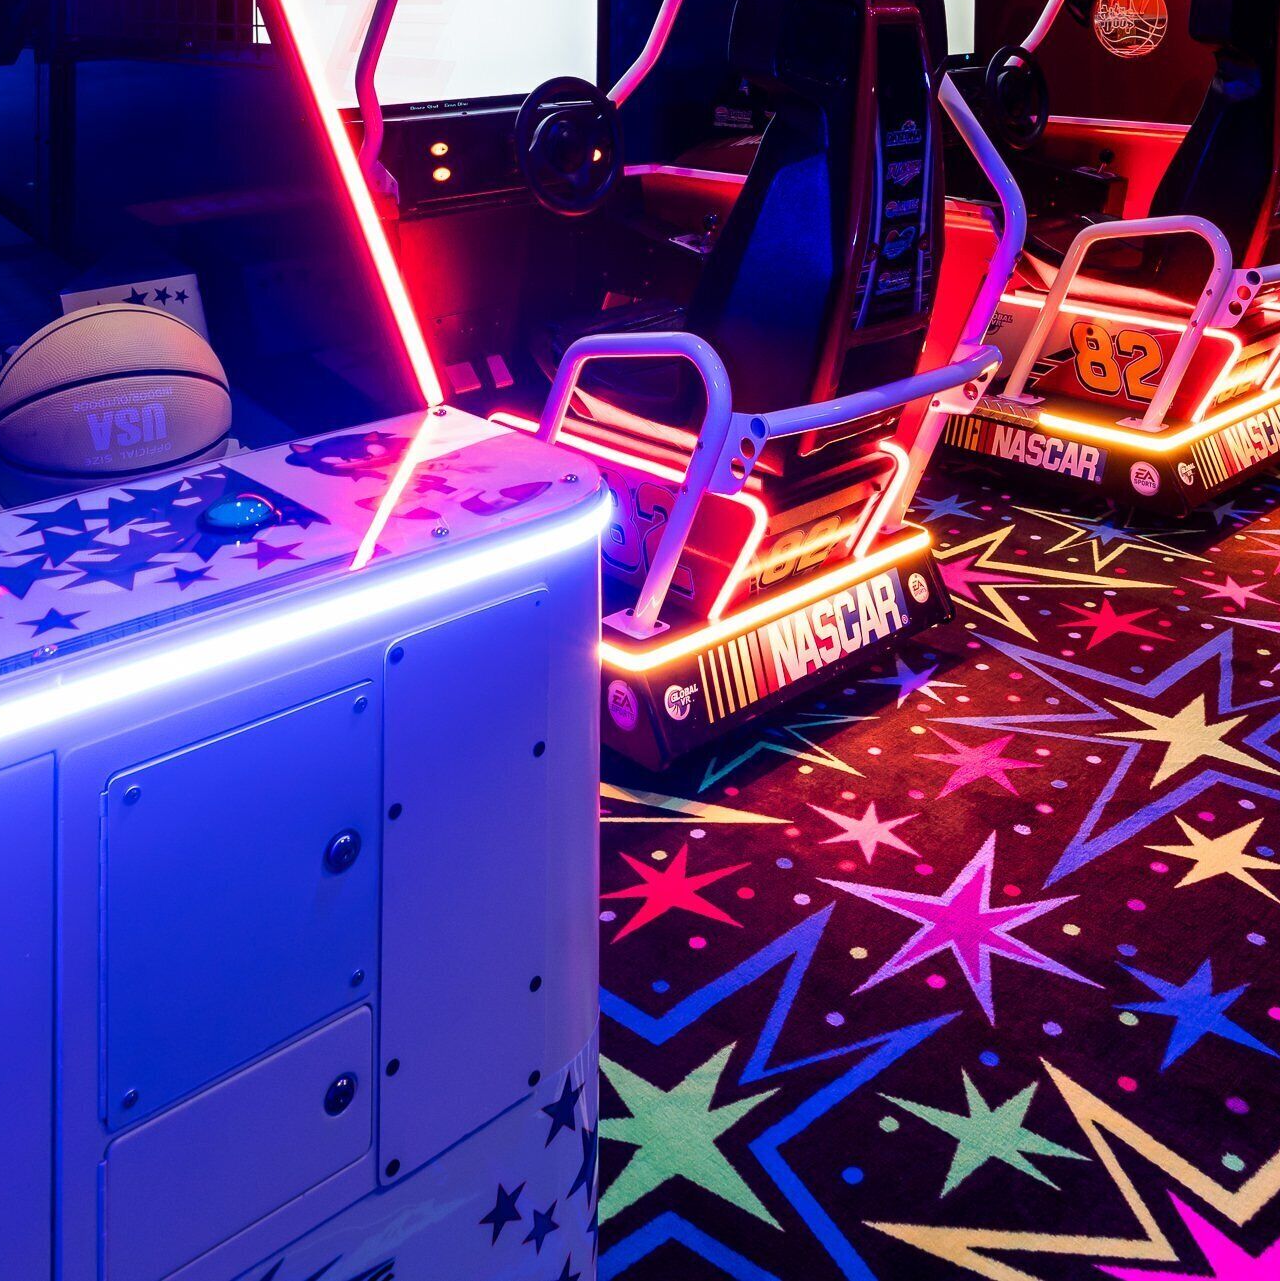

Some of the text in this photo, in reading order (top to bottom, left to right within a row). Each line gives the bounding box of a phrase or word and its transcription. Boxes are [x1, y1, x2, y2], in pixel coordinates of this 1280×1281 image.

[1070, 321, 1163, 404] 82
[87, 402, 167, 451] USA
[991, 424, 1101, 482] NASCAR
[1133, 479, 1157, 489] SPORTS
[1135, 468, 1156, 482] EA
[767, 573, 904, 689] NASCAR
[612, 689, 635, 714] EA
[671, 683, 699, 703] GLOBAL
[681, 696, 692, 706] VR
